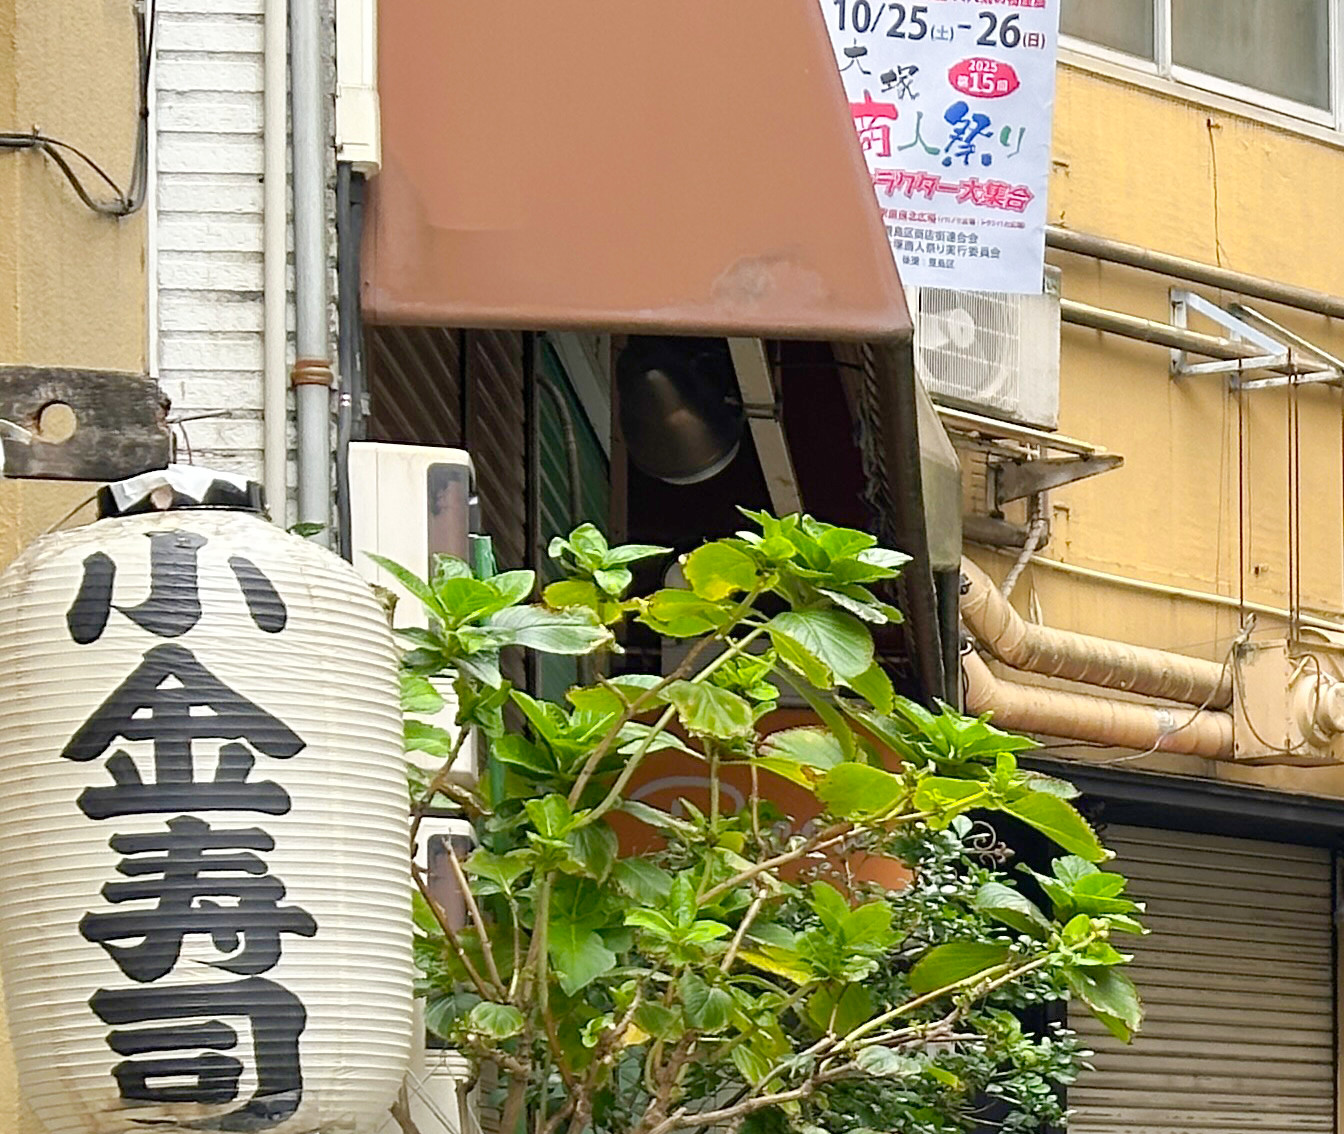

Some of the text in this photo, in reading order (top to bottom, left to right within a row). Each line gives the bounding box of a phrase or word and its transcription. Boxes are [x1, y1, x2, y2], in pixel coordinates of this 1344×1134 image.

[839, 38, 920, 100] 大塚
[957, 72, 1009, 93] 第15回
[968, 60, 998, 73] 2025
[61, 530, 318, 1133] 小金寿司
